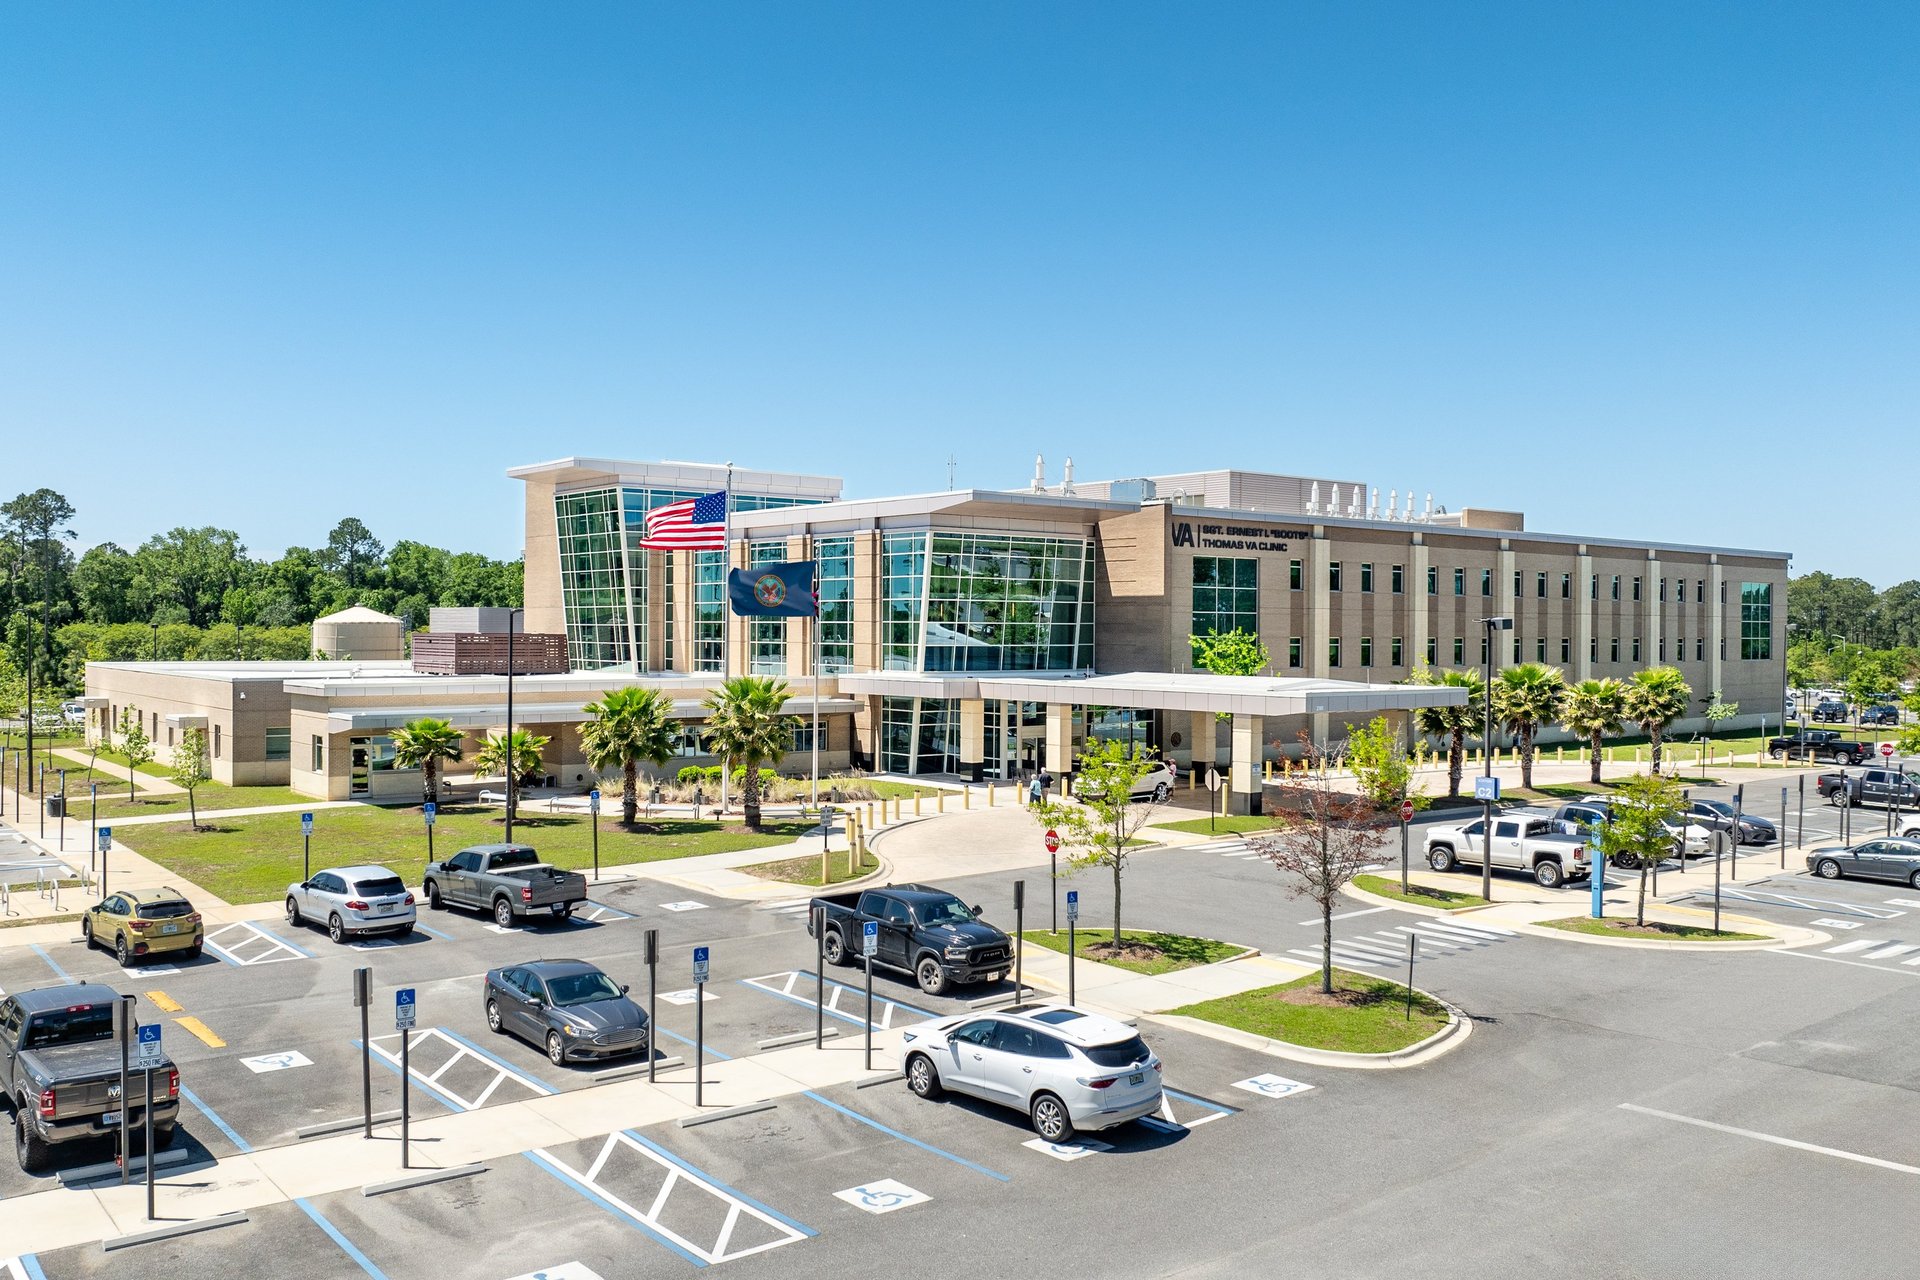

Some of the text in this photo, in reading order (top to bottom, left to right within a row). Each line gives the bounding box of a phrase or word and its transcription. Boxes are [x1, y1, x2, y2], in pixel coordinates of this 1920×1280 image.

[1171, 522, 1195, 547] VA
[1202, 524, 1224, 535] SGT.
[1226, 526, 1263, 537] ERNEST
[1202, 538, 1288, 552] THOMAS VA CLINIC
[1478, 787, 1492, 798] C2
[151, 1058, 161, 1066] FINE
